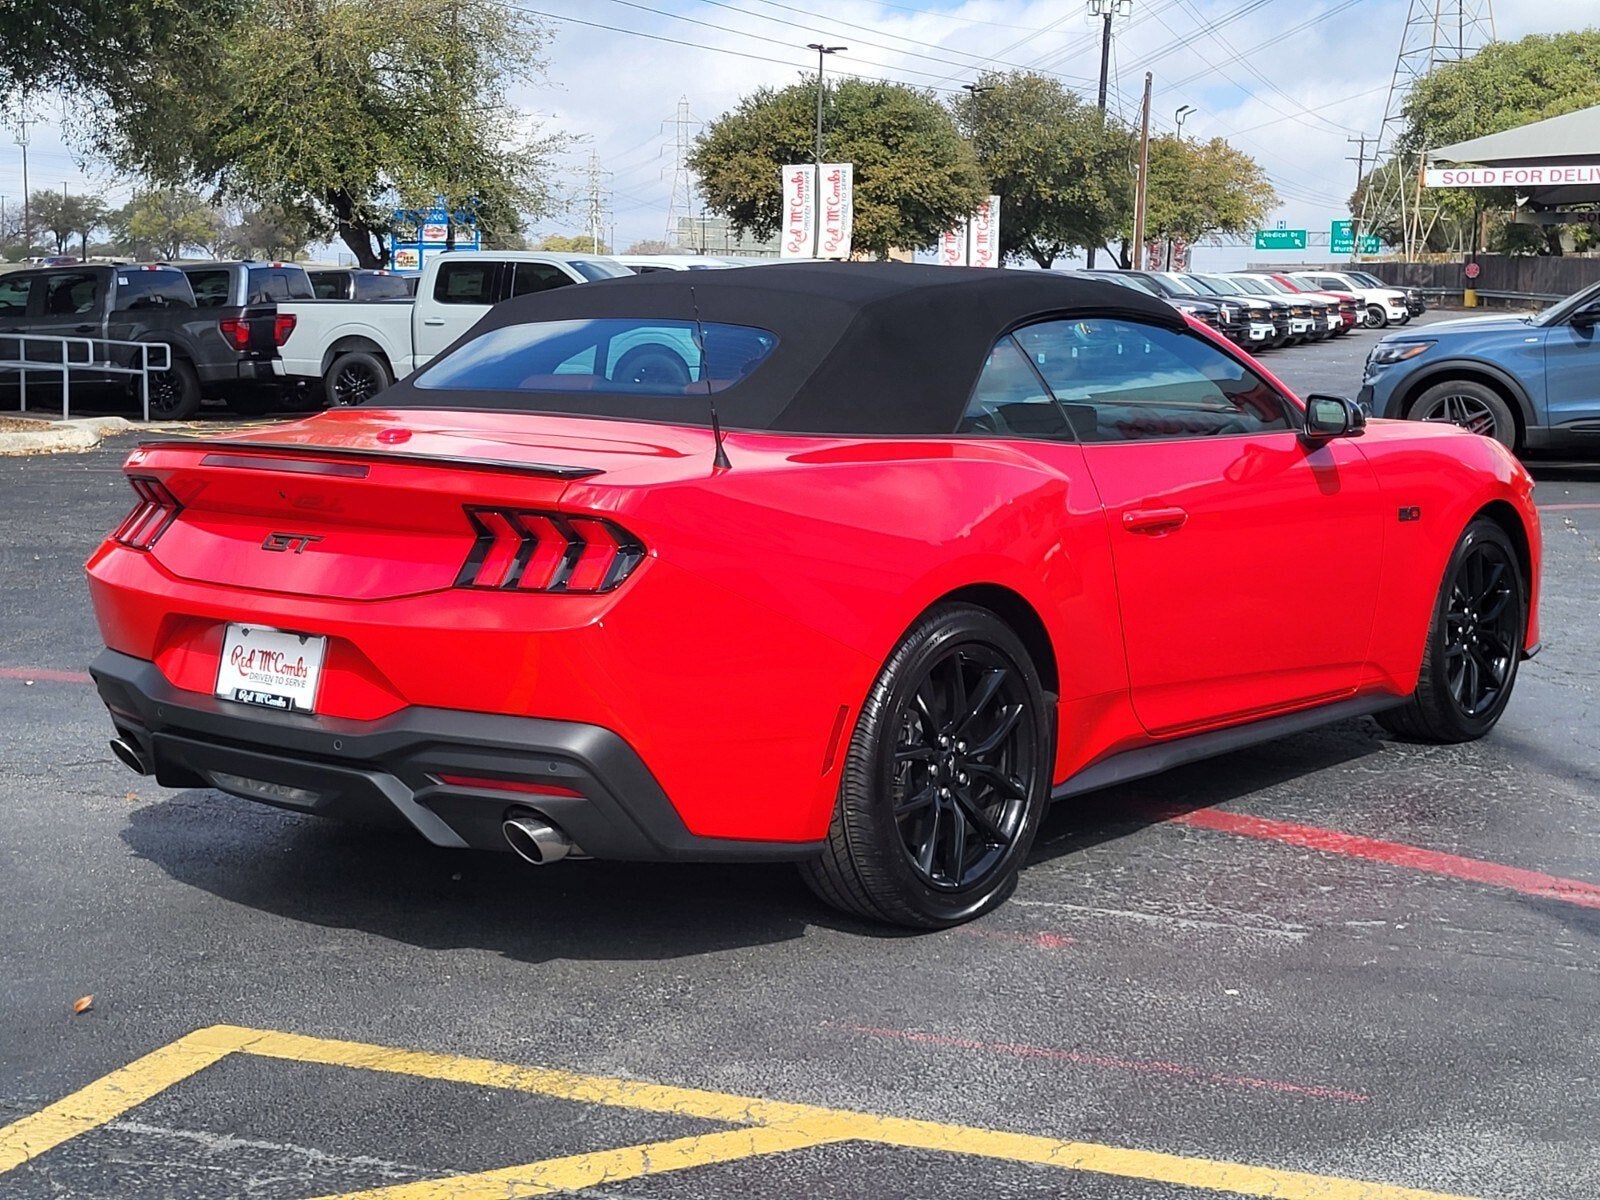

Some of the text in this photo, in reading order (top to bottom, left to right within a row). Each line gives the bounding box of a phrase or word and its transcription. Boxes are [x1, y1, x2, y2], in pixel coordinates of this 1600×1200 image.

[1442, 171, 1496, 185] SOLD
[1502, 170, 1542, 183] FOR
[804, 193, 810, 203] TO
[841, 192, 847, 203] TO
[787, 171, 807, 253] Red McCombs
[824, 169, 844, 252] Red McCombs
[262, 532, 325, 554] GT
[231, 644, 308, 679] Red McCombs
[248, 671, 307, 689] DRIVEN TO SERVE
[238, 689, 287, 708] Red McCombs
